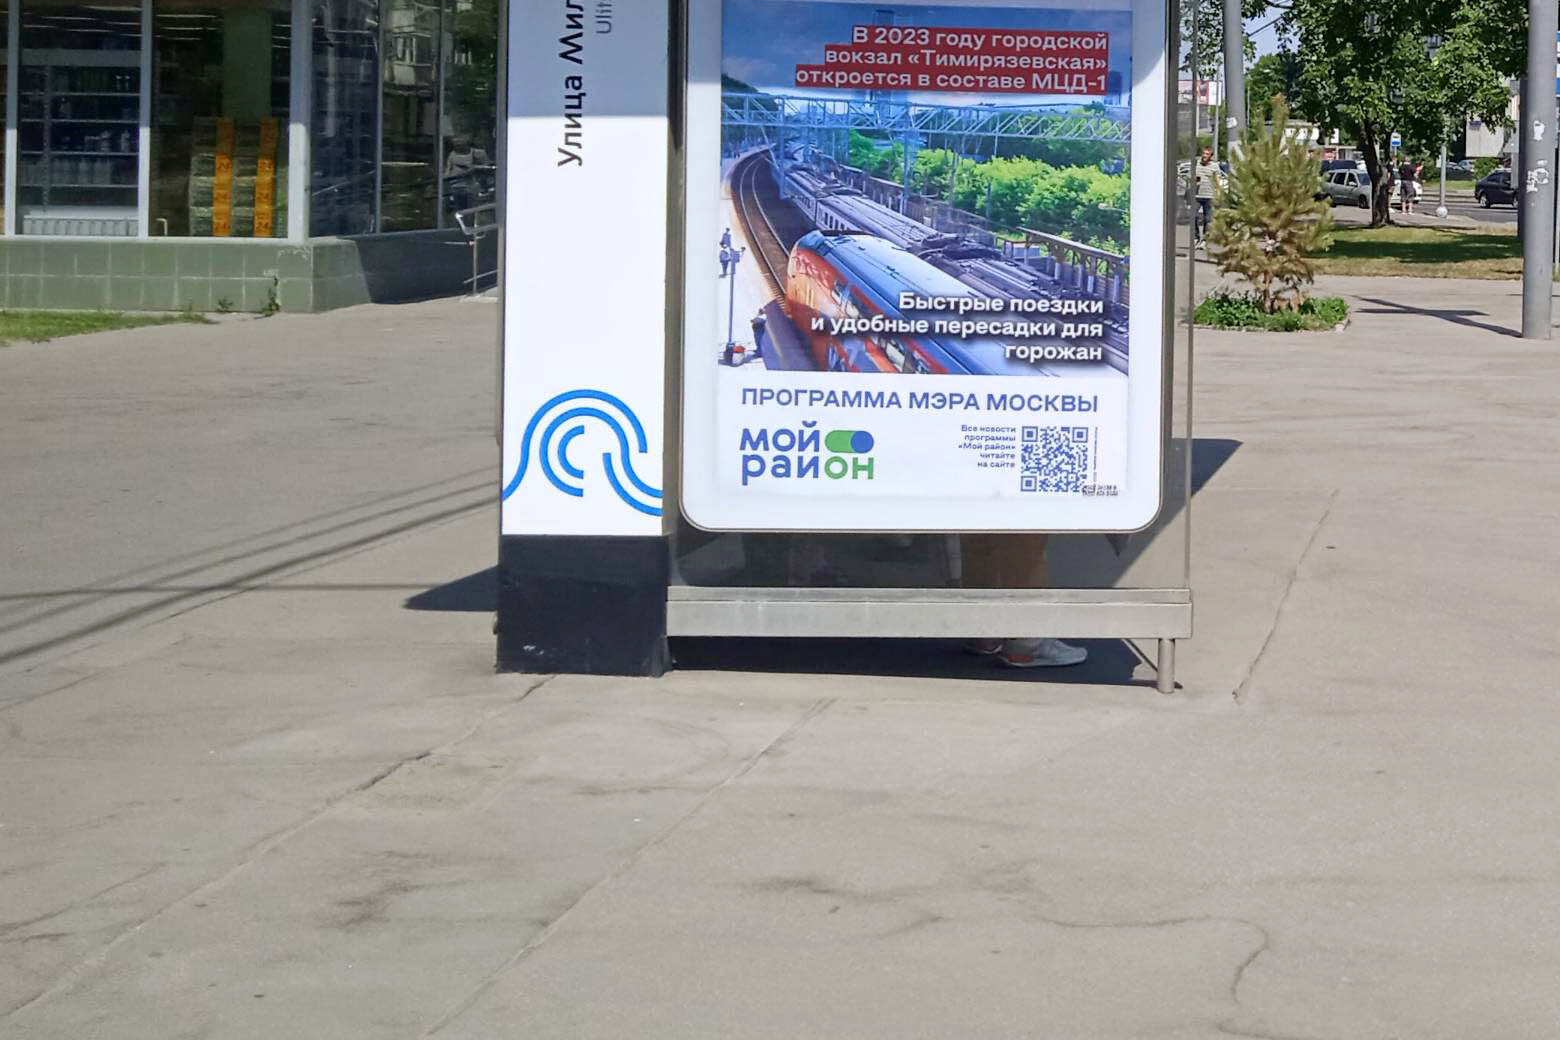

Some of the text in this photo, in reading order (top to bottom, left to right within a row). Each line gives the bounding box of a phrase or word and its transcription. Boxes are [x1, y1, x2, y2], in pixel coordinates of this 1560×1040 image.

[852, 26, 1108, 52] В 2023 году городской
[825, 49, 1108, 72] вокзал «Тимирязевская»
[795, 70, 1106, 94] откроется в составе МЦД-1
[556, 75, 587, 167] Улица
[899, 291, 1105, 316] Быстрые поездки
[810, 314, 1104, 339] и удобные пересадки для
[1004, 344, 1103, 364] горожан
[741, 387, 1098, 413] ПРОГРАММА МЭРА МОСКВЫ
[739, 420, 820, 453] мой
[961, 424, 1016, 433] Все новости
[964, 434, 1016, 442] программы
[980, 451, 1015, 460] читайте
[990, 460, 1015, 468] сайте
